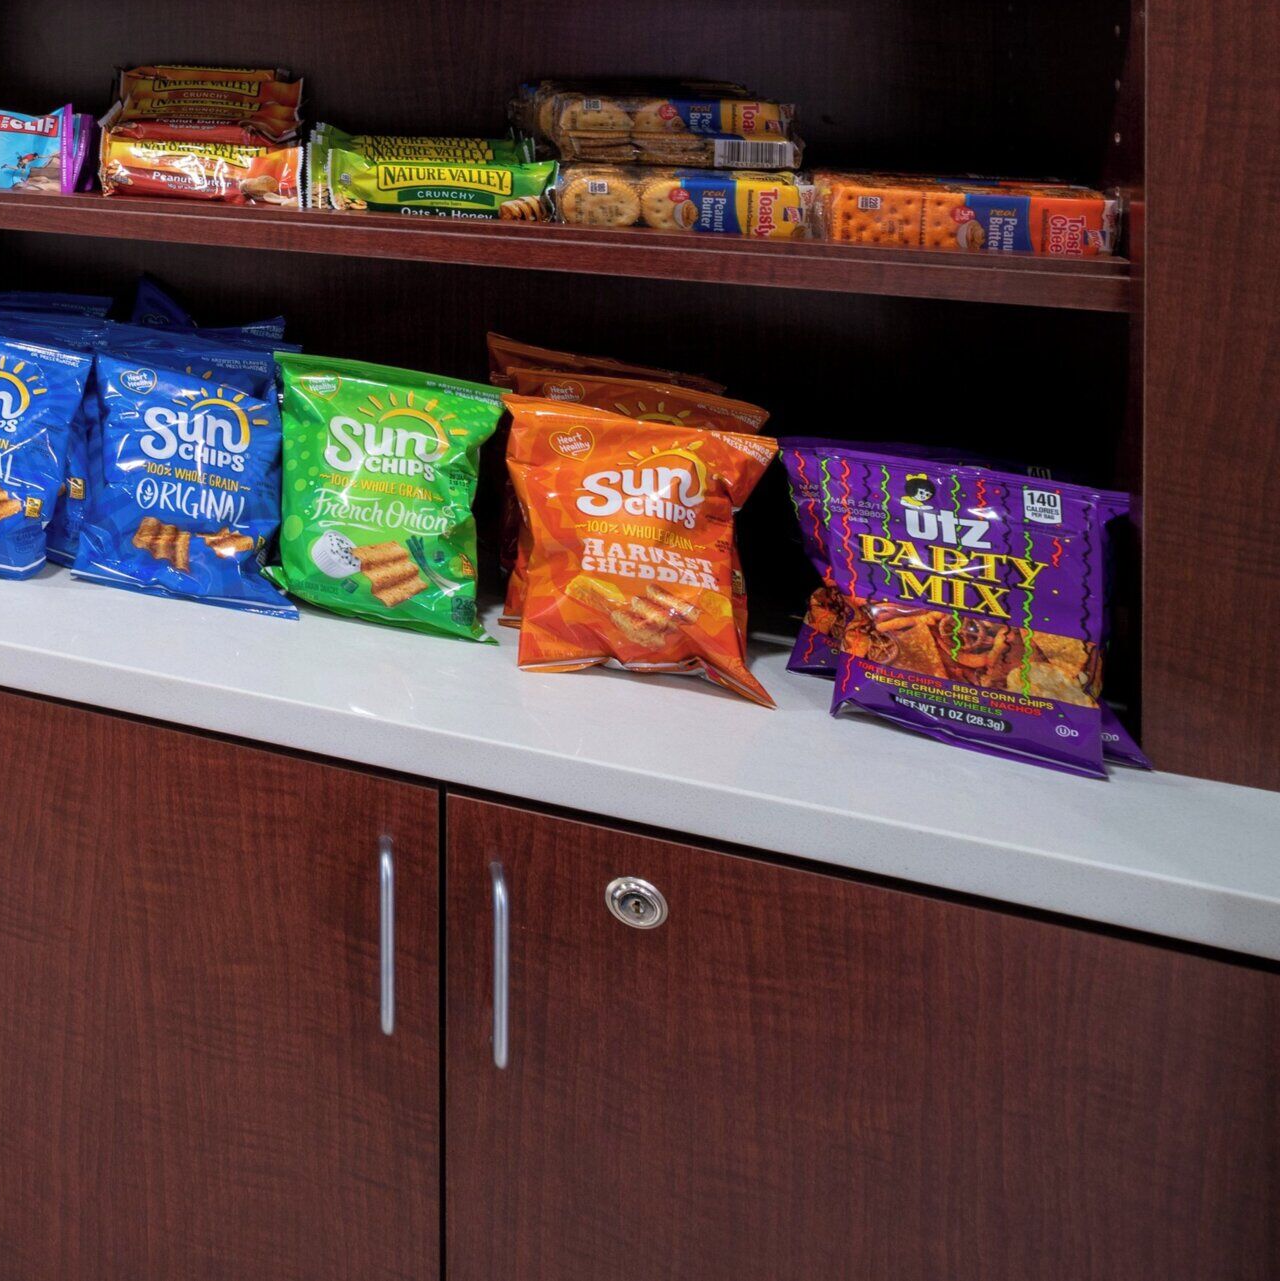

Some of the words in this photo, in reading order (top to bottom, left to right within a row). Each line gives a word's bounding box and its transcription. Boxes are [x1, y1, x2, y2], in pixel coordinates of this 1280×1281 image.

[152, 170, 192, 184] Peanut
[383, 166, 446, 186] NATURE
[448, 169, 506, 191] VALLEY
[417, 191, 475, 200] CRUNCHY
[556, 433, 584, 445] Heart
[559, 441, 591, 453] Healthy
[146, 464, 172, 477] 100%
[174, 467, 207, 485] WHOLE
[208, 478, 239, 492] GRAIN
[313, 488, 384, 522] French
[386, 500, 449, 534] Onion
[1026, 492, 1057, 508] 140
[1026, 505, 1060, 516] CALORIES
[582, 537, 714, 575] HARVEST
[858, 534, 1048, 589] PARTY
[581, 555, 720, 592] CHEDDAR
[895, 570, 1012, 618] MIX
[865, 672, 909, 689] CHEESE
[911, 682, 980, 703] CRUNCHIES
[952, 684, 978, 696] BBQ
[981, 691, 1017, 702] CORN
[1018, 697, 1054, 710] CHIPS
[895, 696, 917, 709] NET
[918, 704, 937, 716] WT
[939, 707, 945, 718] 1
[948, 708, 963, 721] OZ
[967, 714, 1005, 732] (28.3g)
[898, 688, 950, 703] PRETZEL
[953, 699, 1003, 716] WHEELS
[989, 699, 1042, 716] NACHOS
